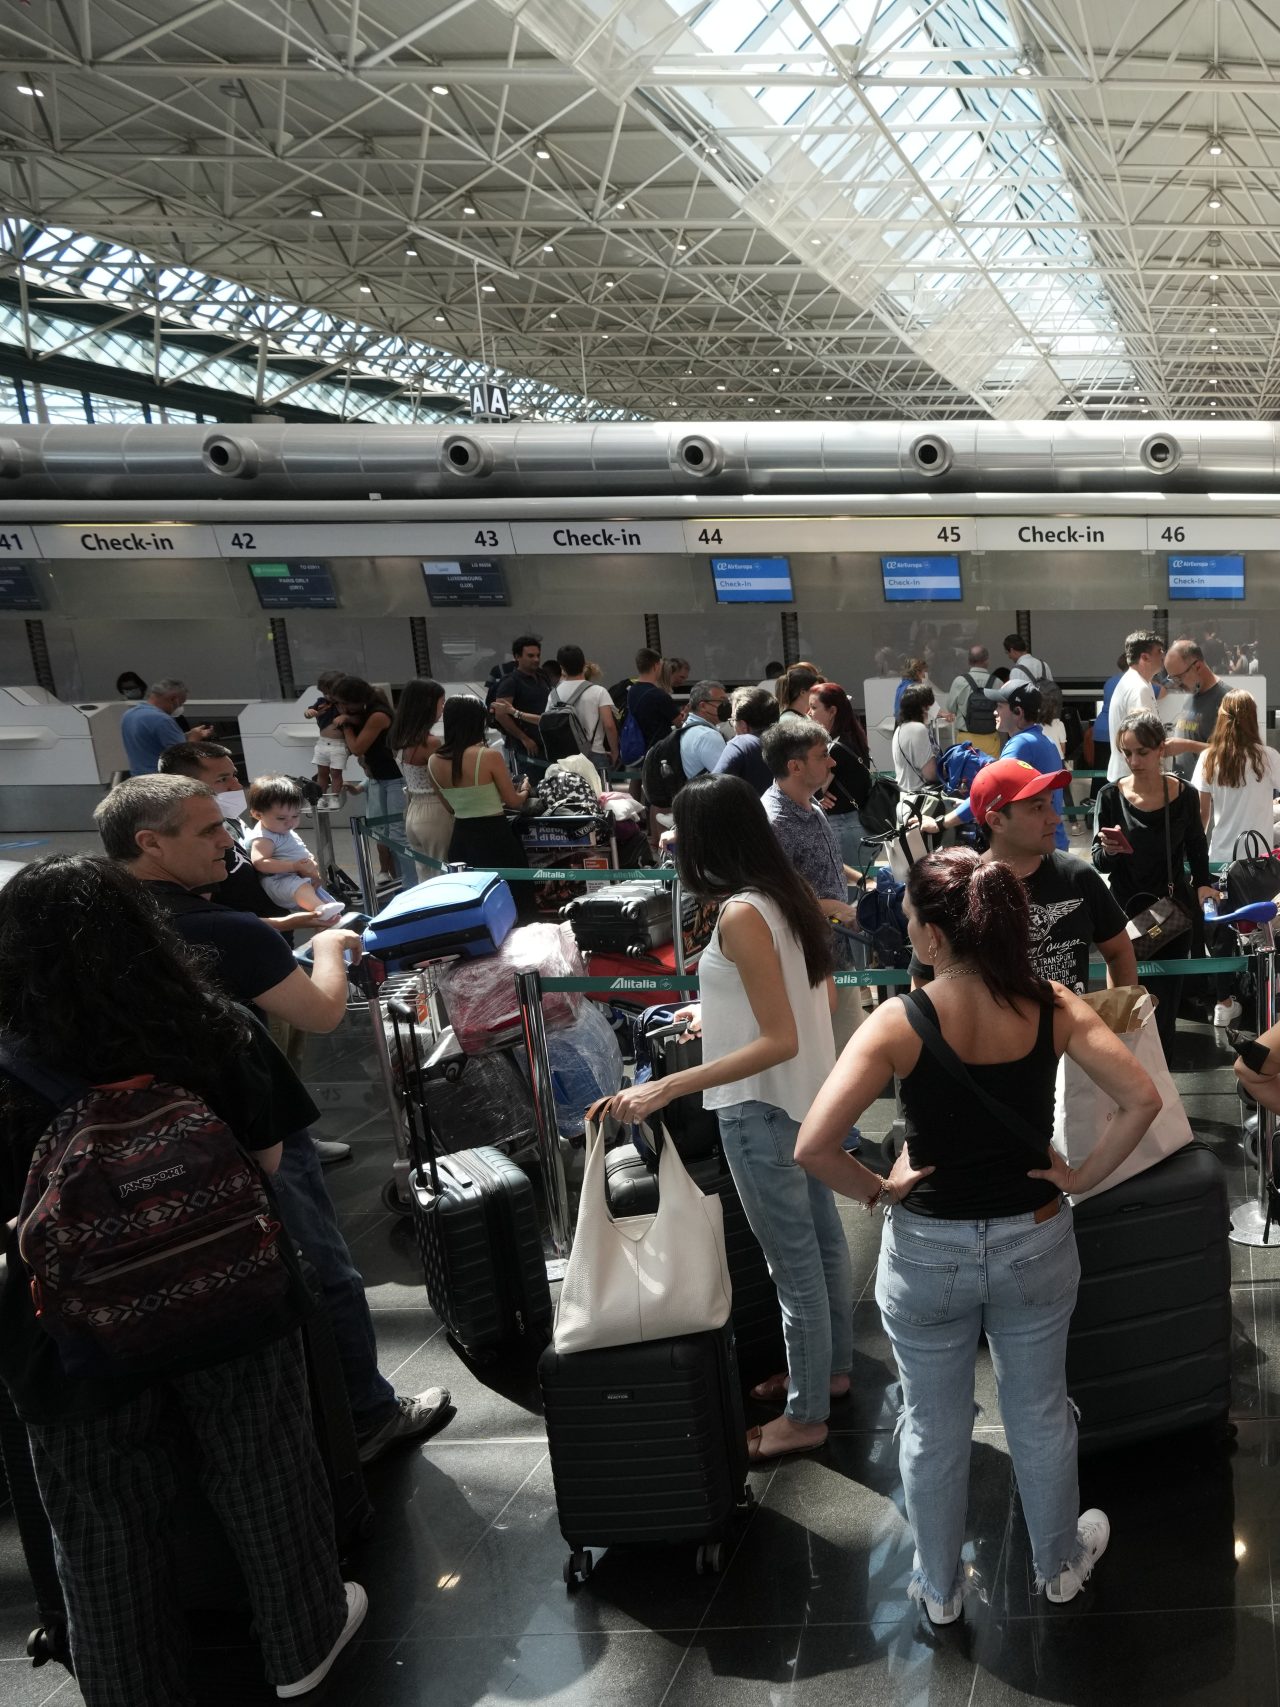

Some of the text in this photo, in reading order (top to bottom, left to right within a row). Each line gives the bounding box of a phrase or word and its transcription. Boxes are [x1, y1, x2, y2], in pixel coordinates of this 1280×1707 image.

[472, 386, 485, 413] A
[490, 387, 508, 415] A
[0, 533, 23, 551] 41
[80, 532, 174, 552] Check-in
[230, 532, 257, 551] 42
[474, 530, 499, 548] 43
[553, 528, 641, 548] Check-in
[698, 528, 723, 546] 44
[937, 526, 962, 543] 45
[1018, 525, 1105, 544] Check-in
[1161, 526, 1186, 543] 46
[533, 869, 566, 878] Alitalia
[609, 977, 657, 989] Alitalia
[833, 974, 858, 984] talia
[119, 1164, 187, 1199] JANSPORT
